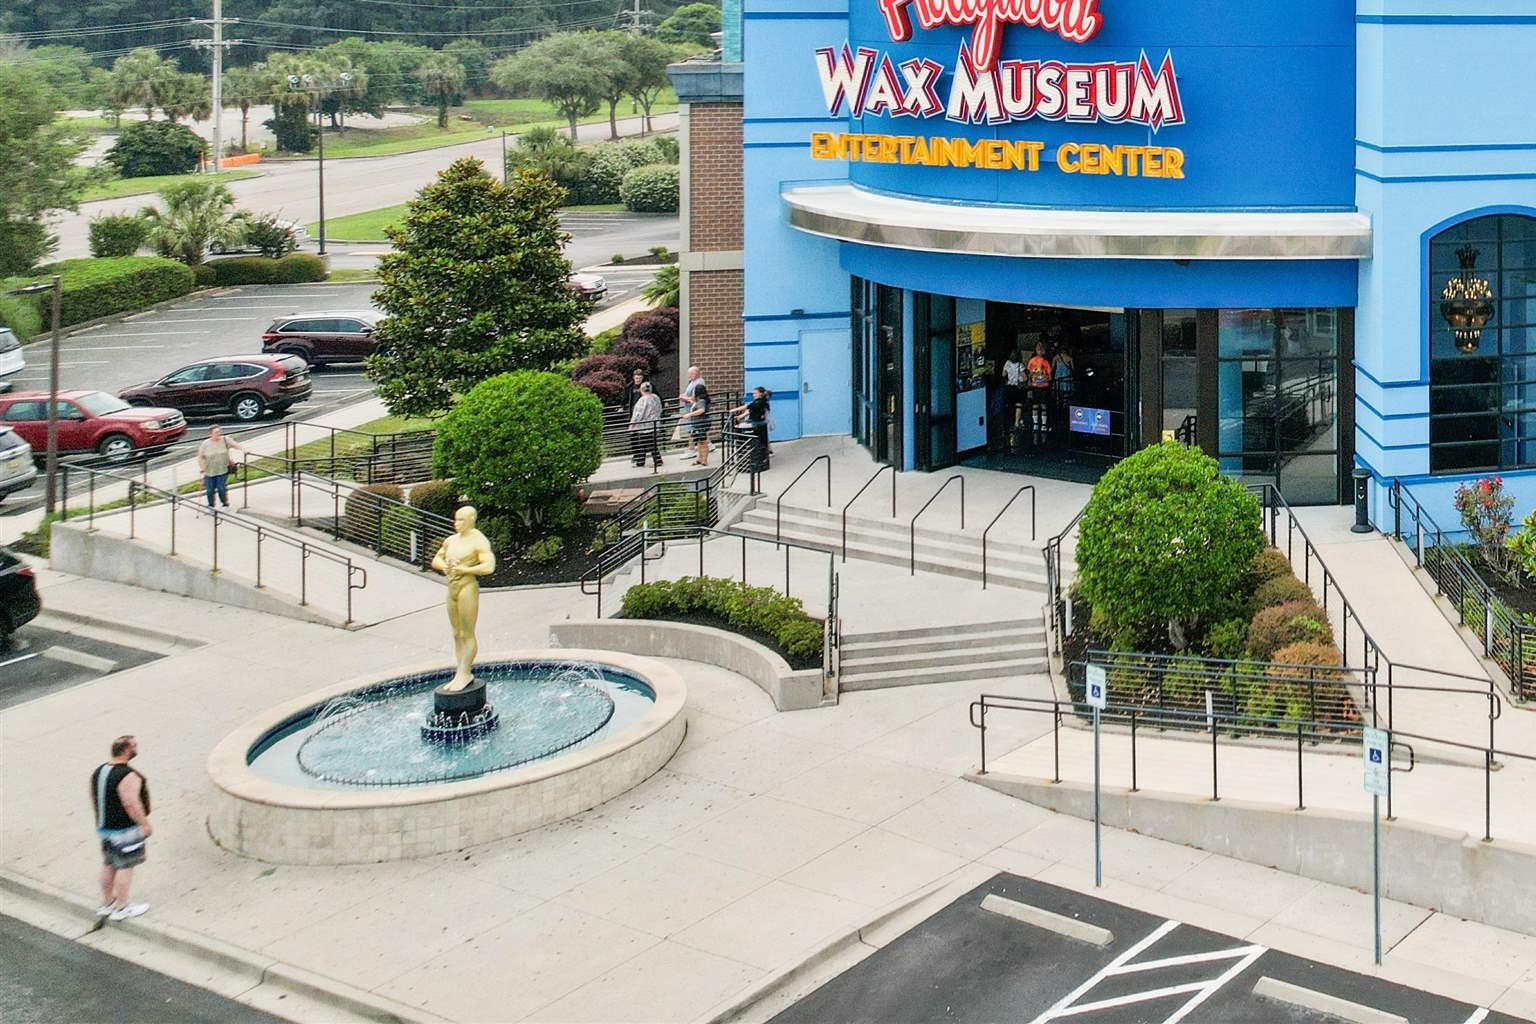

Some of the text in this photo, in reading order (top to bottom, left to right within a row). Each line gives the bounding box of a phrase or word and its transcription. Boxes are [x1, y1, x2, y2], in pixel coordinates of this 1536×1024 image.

[816, 38, 1186, 134] WAX MUSEUM
[811, 132, 1185, 179] ENTERTAINMENT CENTER
